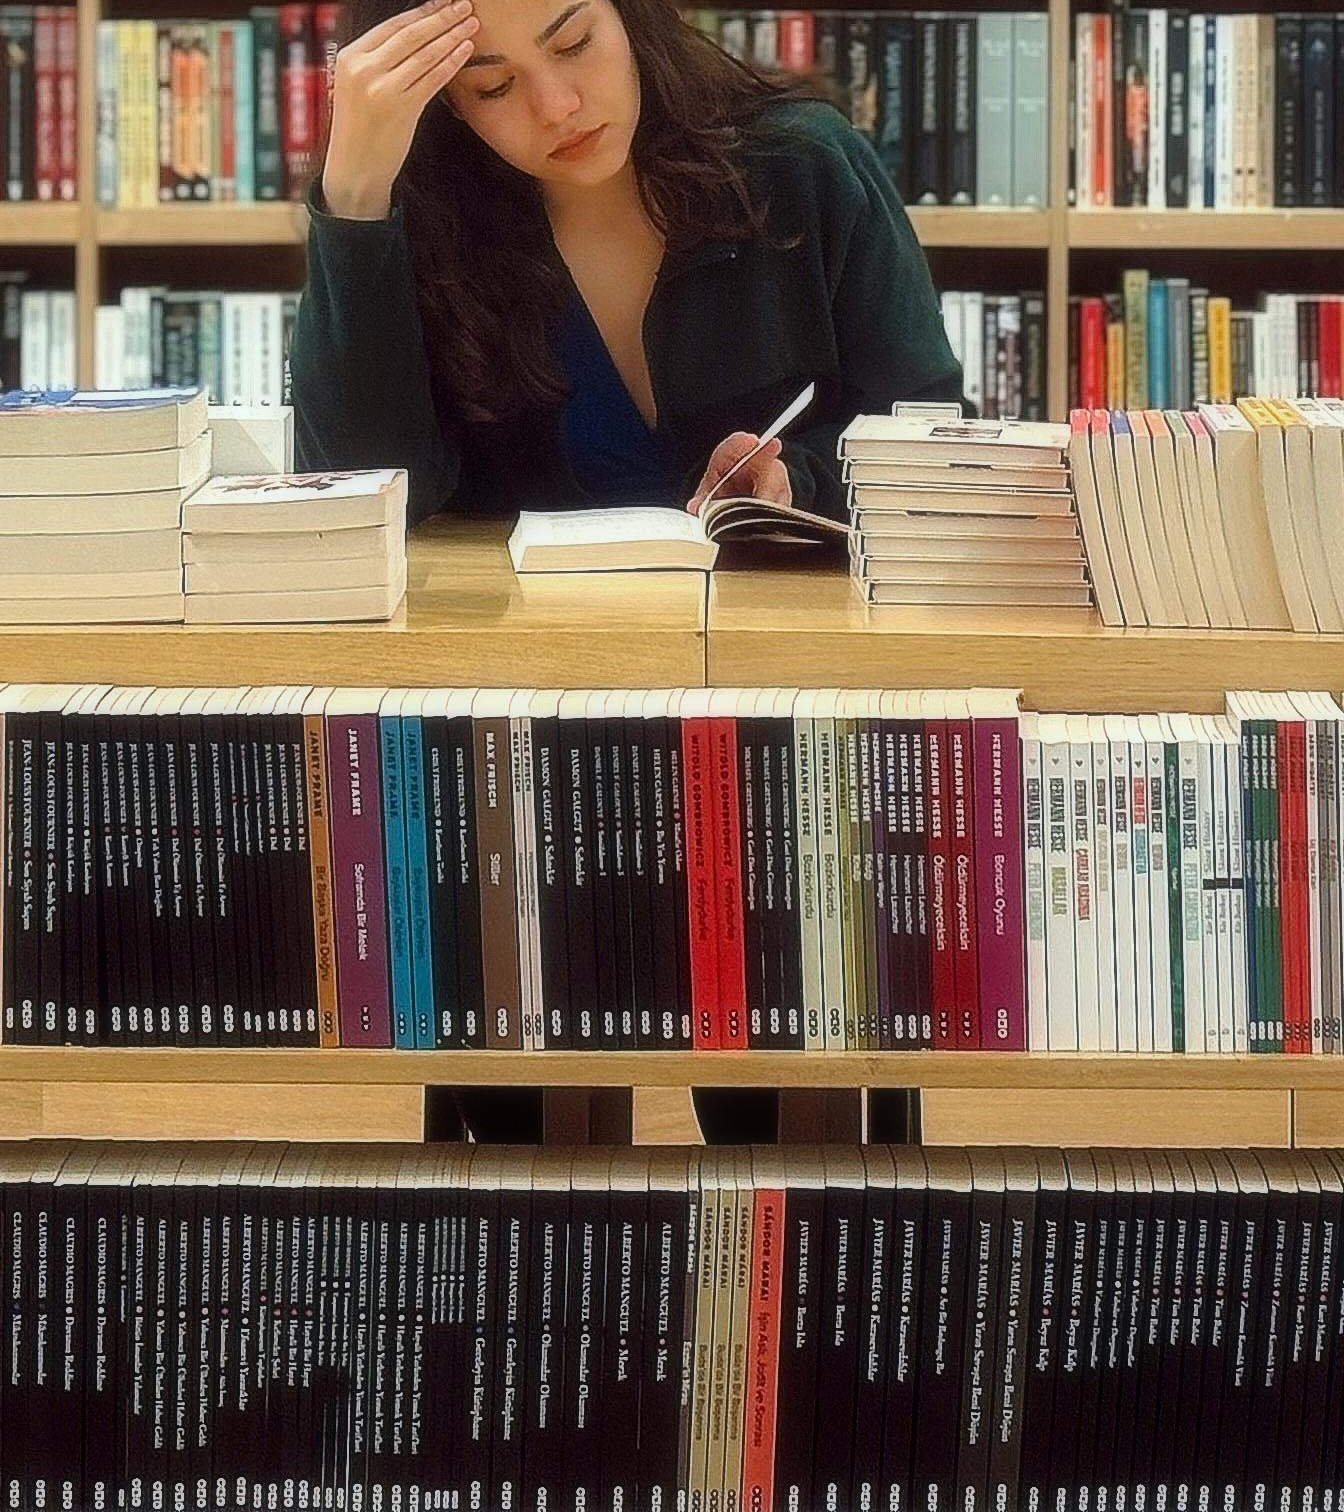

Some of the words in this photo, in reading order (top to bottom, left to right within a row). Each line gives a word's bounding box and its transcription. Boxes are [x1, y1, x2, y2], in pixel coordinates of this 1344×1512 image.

[347, 728, 359, 768] JANET
[486, 732, 496, 760] MAX
[820, 733, 832, 793] HERMANN
[953, 734, 964, 795] HERMANN
[991, 734, 1002, 795] HERMANN
[311, 774, 322, 816] FRAME
[350, 773, 361, 816] FRAME
[486, 764, 497, 808] FRISCH
[822, 798, 833, 835] HESSE
[955, 800, 965, 838] HESSE
[992, 799, 1003, 837] HESSE
